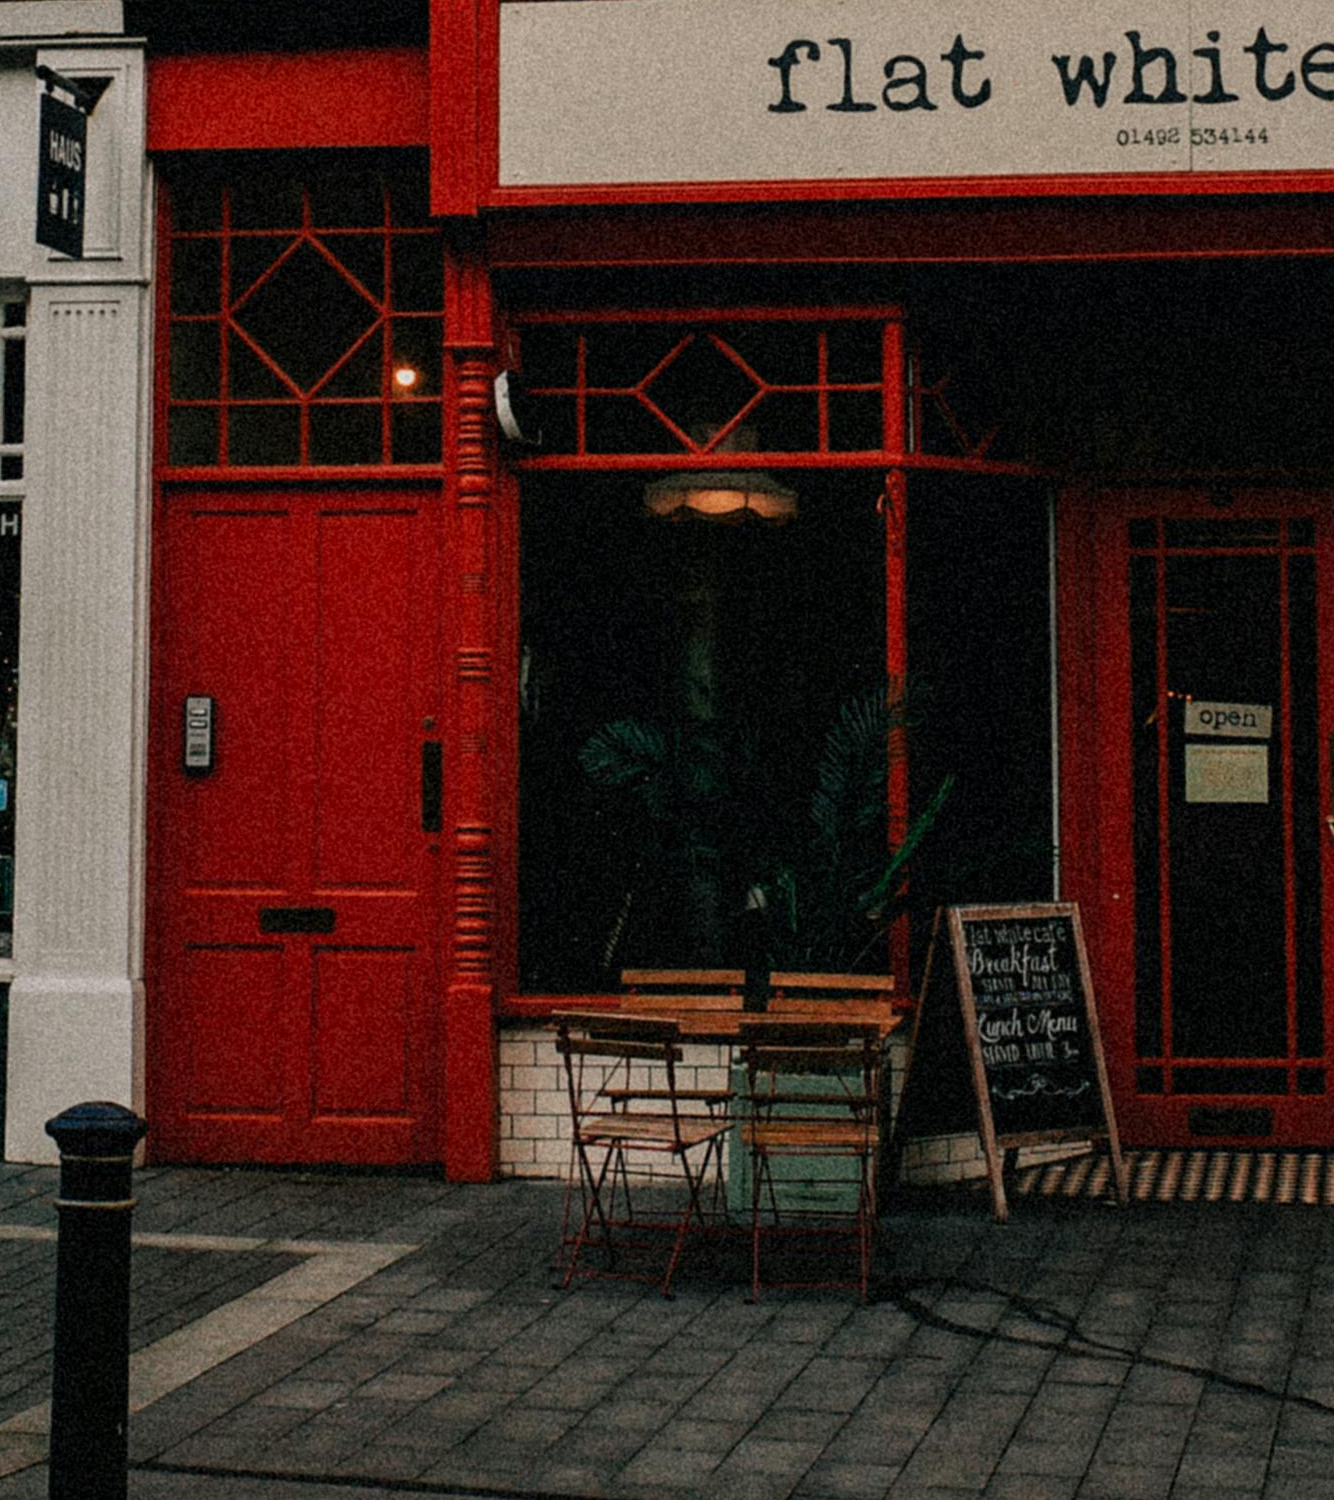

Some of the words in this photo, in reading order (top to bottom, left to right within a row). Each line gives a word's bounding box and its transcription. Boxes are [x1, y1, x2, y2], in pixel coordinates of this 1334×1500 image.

[766, 34, 993, 113] flat
[48, 129, 83, 172] HAUS
[1116, 128, 1181, 146] 01492
[1190, 127, 1269, 146] 534144
[1199, 709, 1258, 731] open
[971, 943, 1058, 987] Breakfast
[977, 1007, 1025, 1043] Lunch
[1027, 1008, 1078, 1041] Menu
